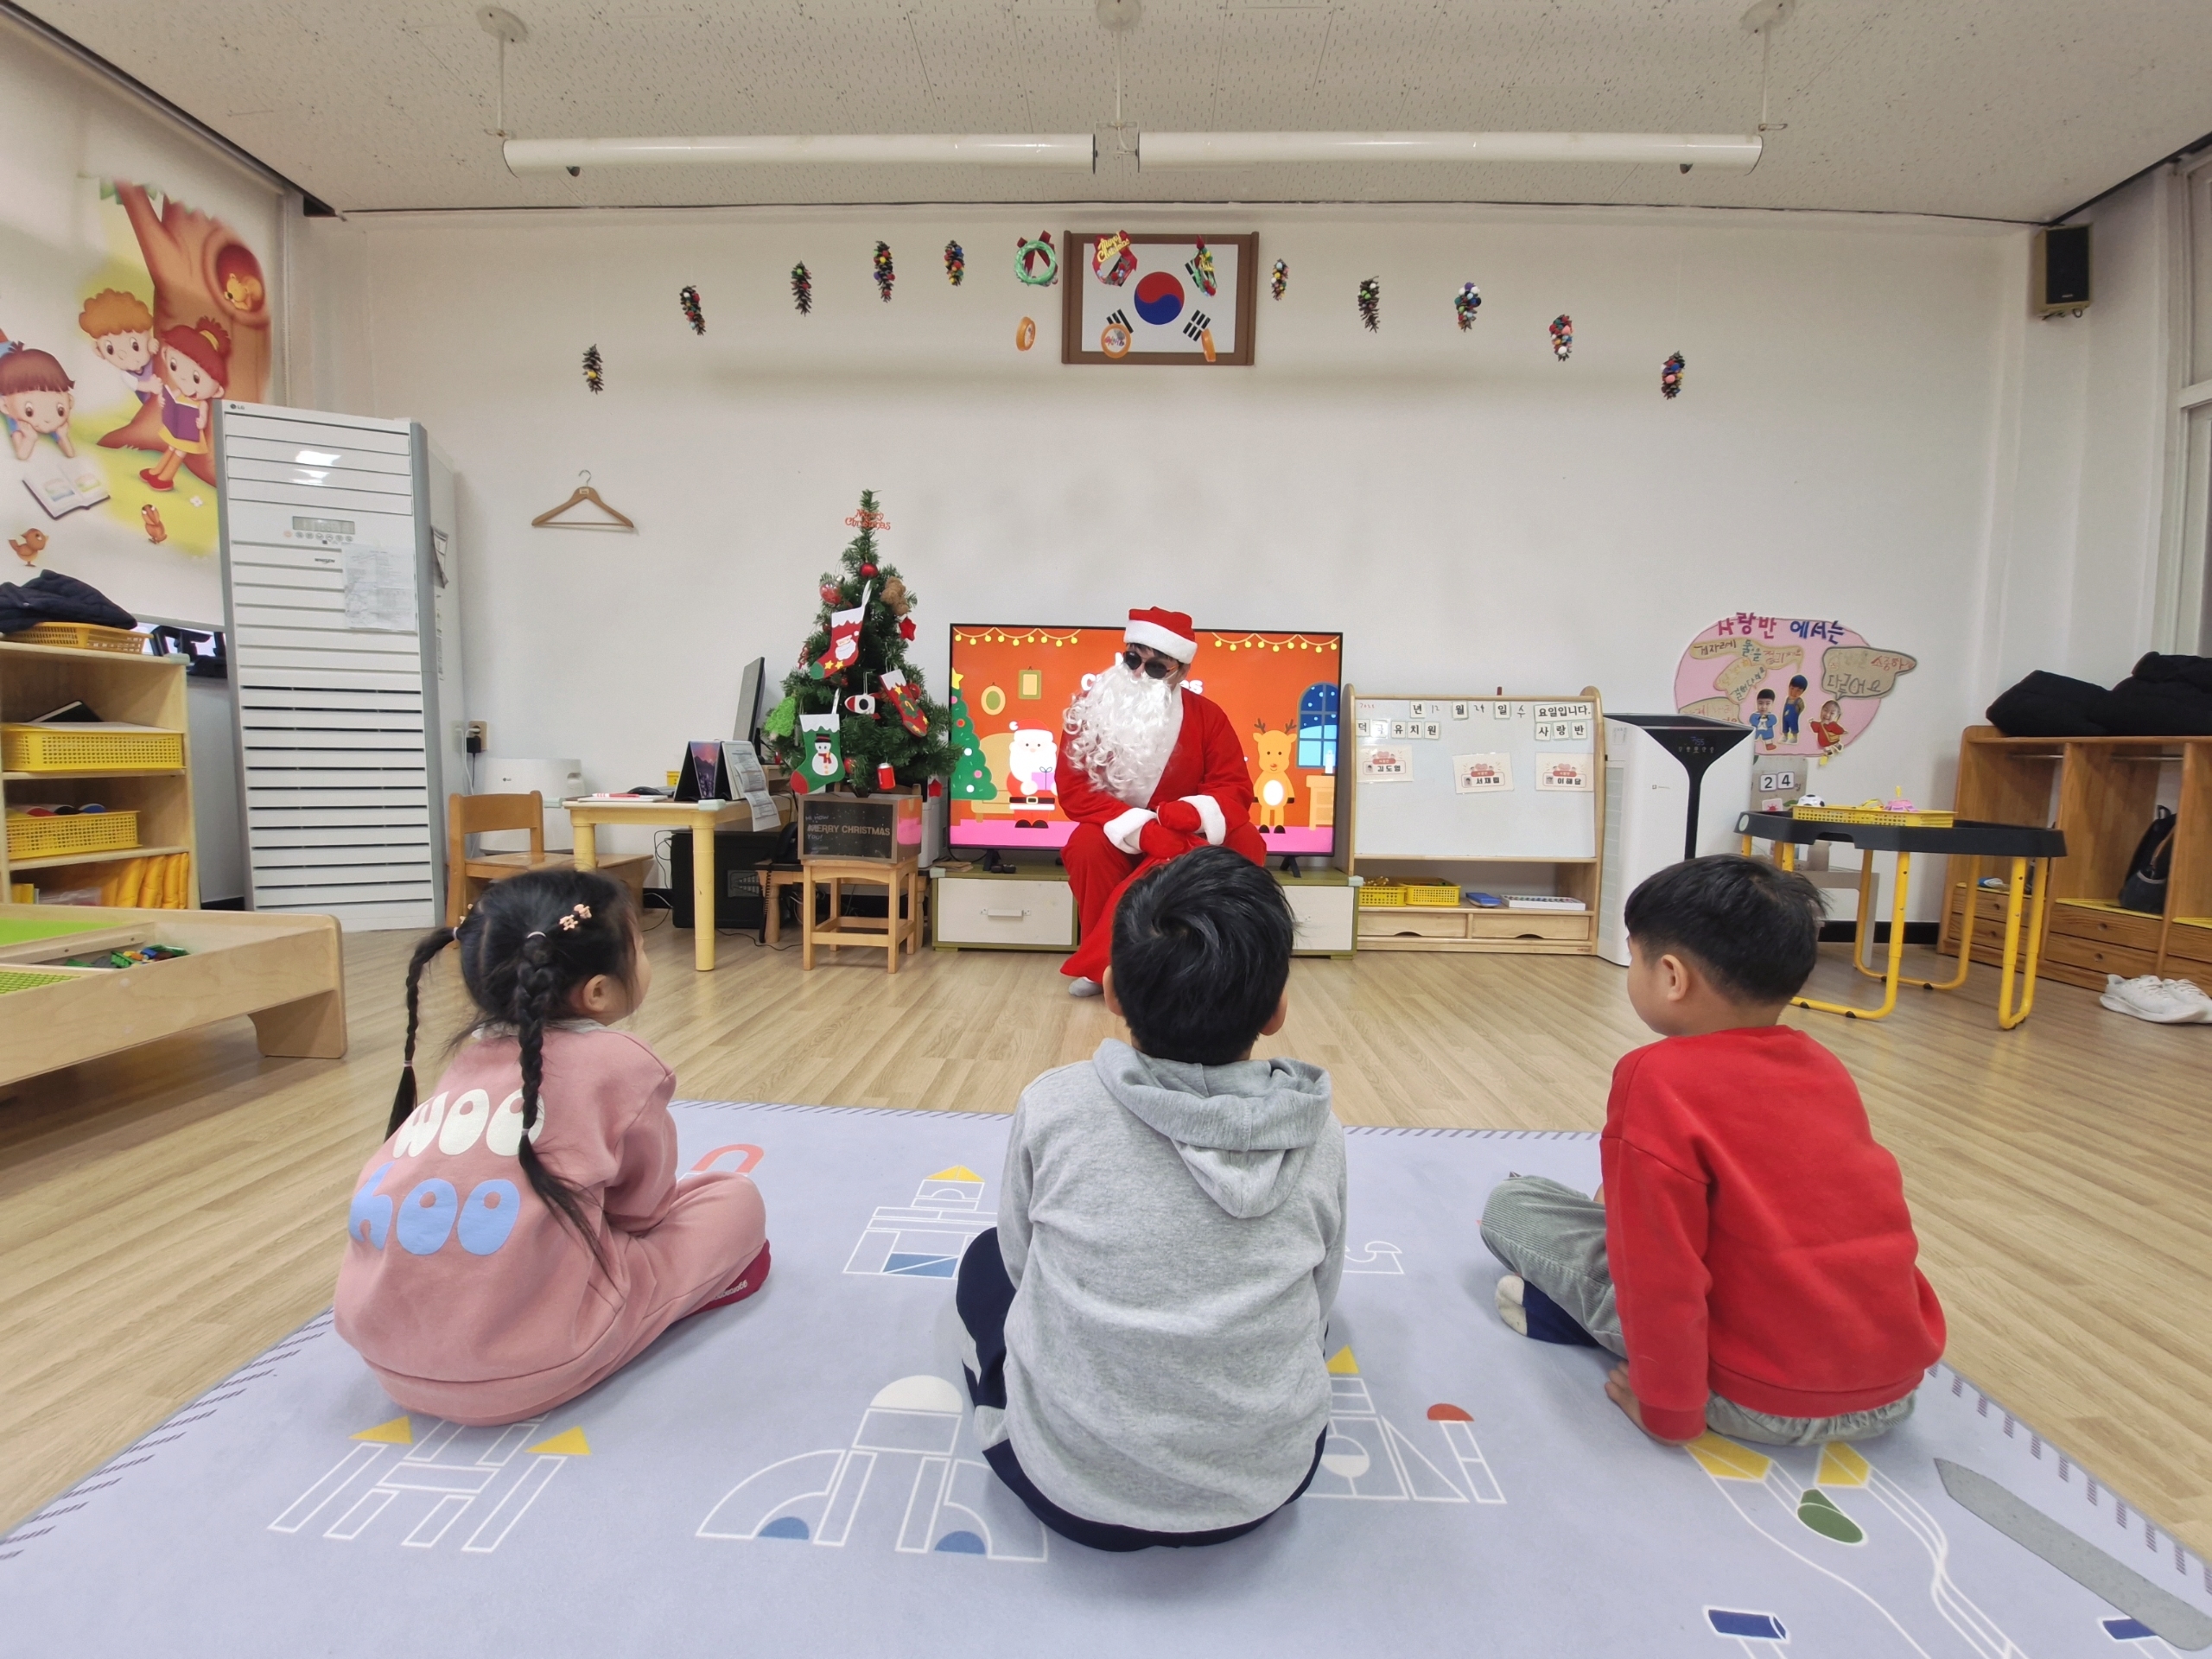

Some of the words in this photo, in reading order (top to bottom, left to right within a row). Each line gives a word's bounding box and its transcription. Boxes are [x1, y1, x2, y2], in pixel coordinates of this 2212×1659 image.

[1719, 612, 1777, 639] 사랑반
[1789, 620, 1845, 645] 에서는
[1413, 704, 1423, 715] 년
[1455, 704, 1465, 715] 월
[1497, 704, 1507, 715] 일
[1516, 704, 1526, 718] 수
[1538, 724, 1585, 737] 사랑반
[1764, 774, 1791, 790] 24
[807, 823, 840, 836] MERRY
[841, 824, 891, 836] CHRISTMAS
